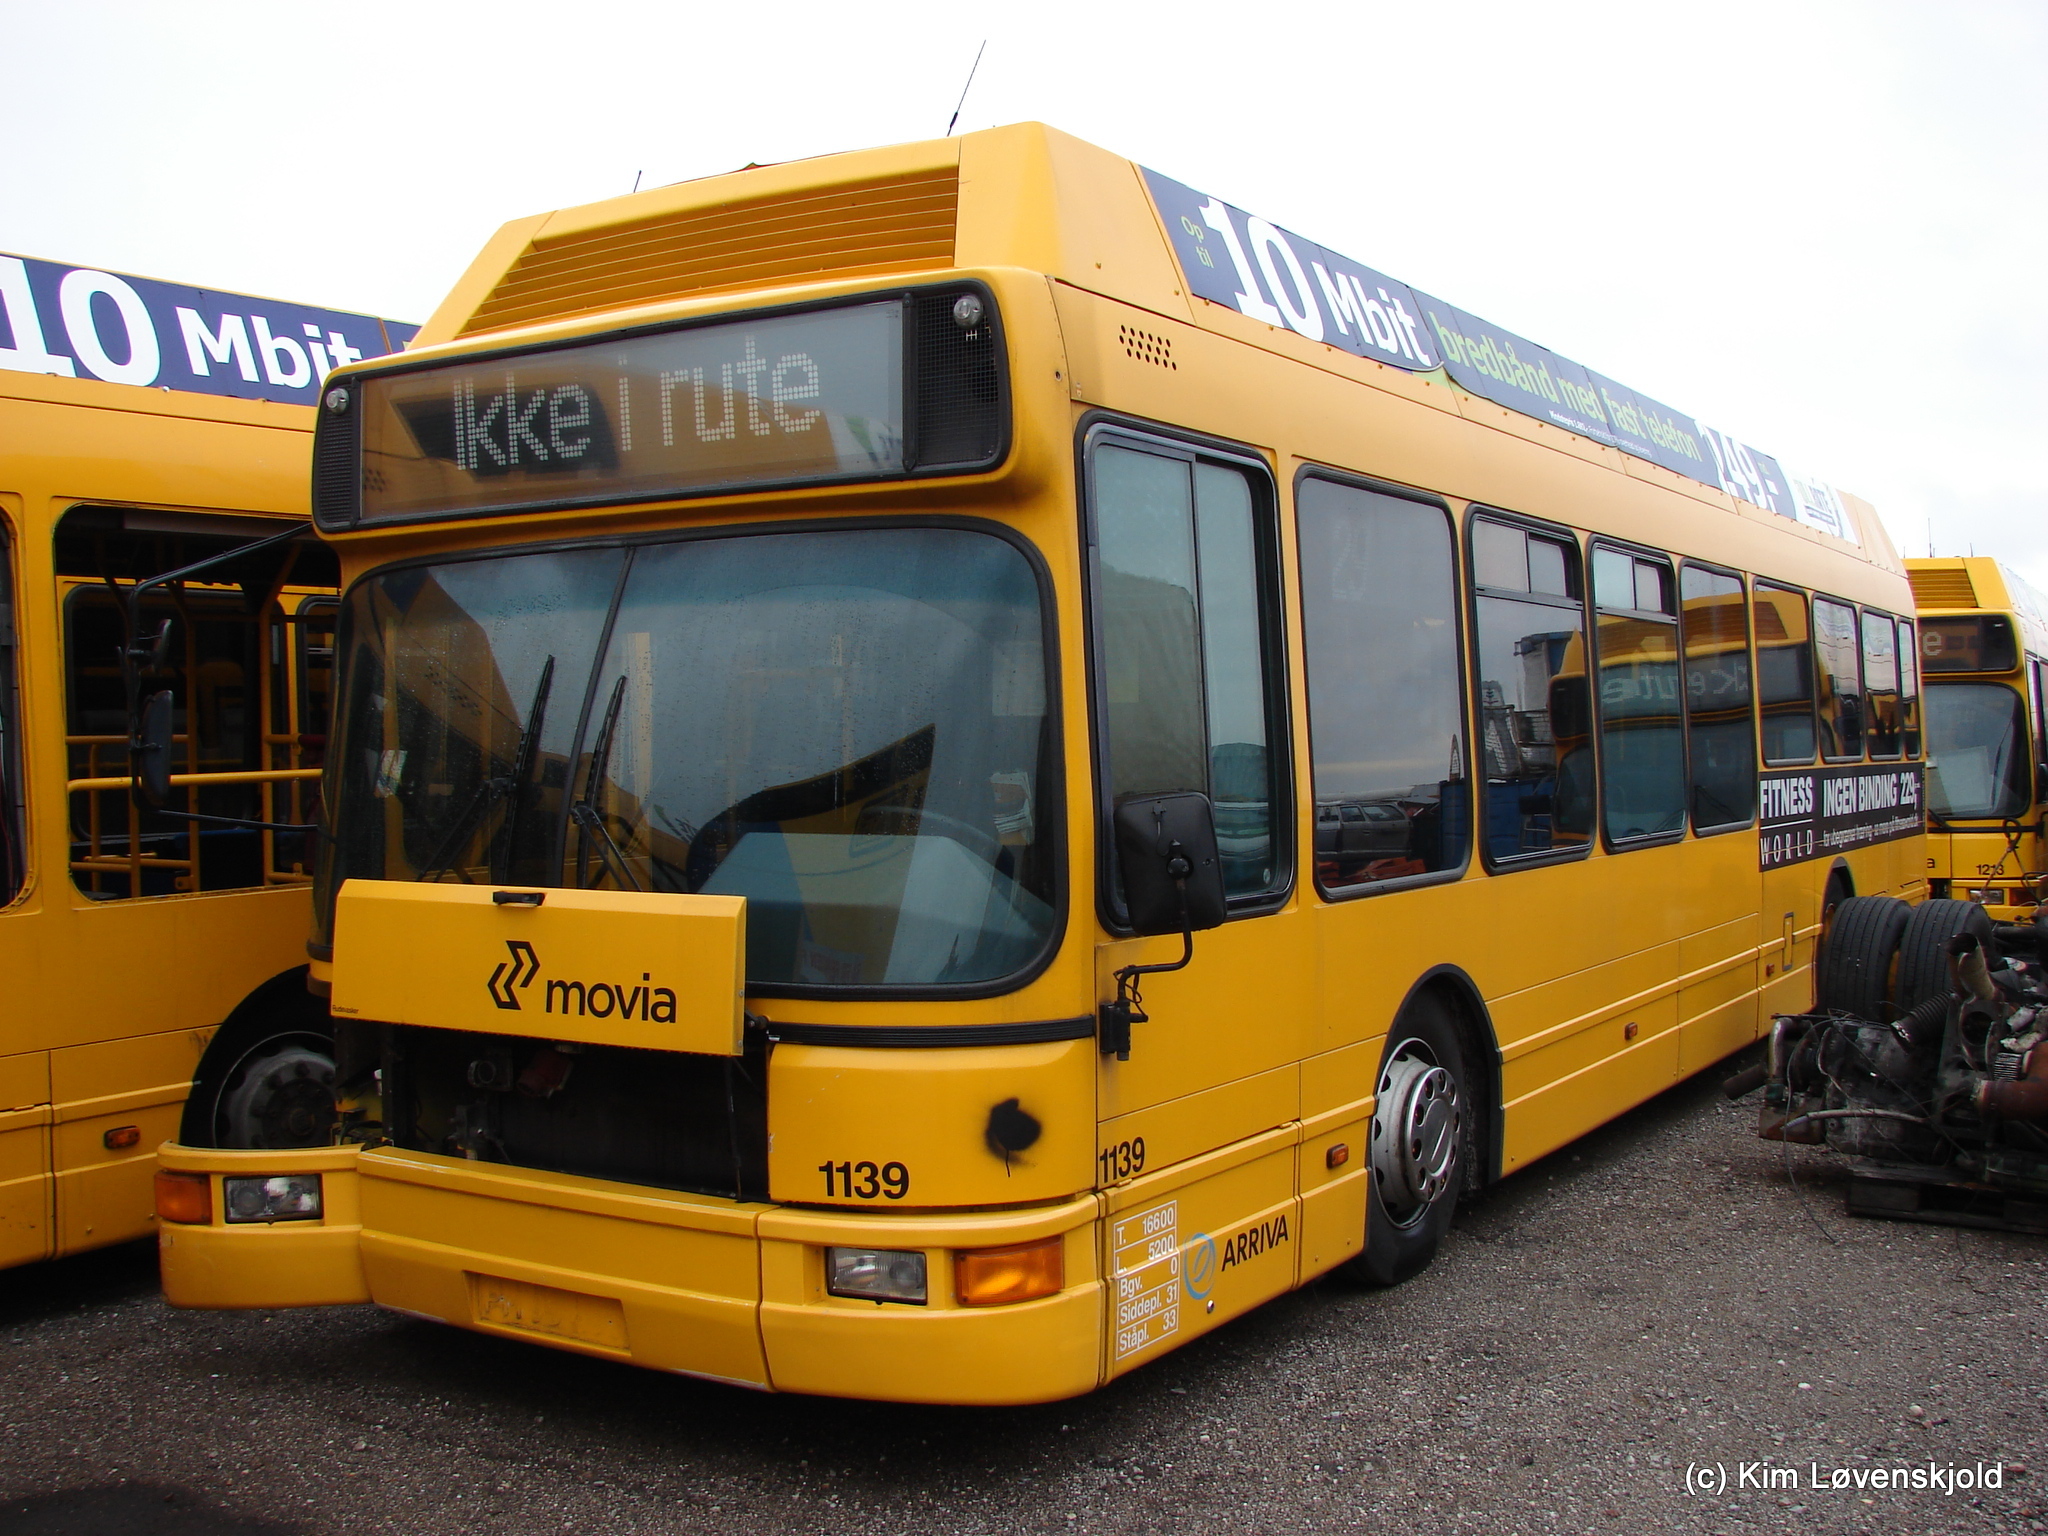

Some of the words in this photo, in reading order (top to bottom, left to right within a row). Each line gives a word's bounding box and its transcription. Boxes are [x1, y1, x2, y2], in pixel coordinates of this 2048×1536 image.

[1180, 216, 1205, 243] Op
[1194, 246, 1215, 269] til
[1198, 196, 1324, 342] 10
[1311, 261, 1432, 367] Mbit
[453, 370, 592, 470] Ikke
[617, 353, 632, 452] i
[660, 333, 821, 447] rute
[1428, 311, 1560, 404] bredbånd
[1556, 376, 1608, 424] med
[1601, 387, 1647, 439] fast
[1639, 406, 1703, 462] telefon
[1760, 776, 1813, 820] FITNESS
[1823, 775, 1857, 818] INGEN
[1858, 773, 1897, 812] BINDING
[1760, 829, 1813, 865] WORLD
[545, 972, 676, 1024] movia
[818, 1160, 910, 1200] 1139
[1100, 1136, 1145, 1184] 1139
[1117, 1227, 1126, 1246] T.
[1142, 1207, 1174, 1236] 16600
[1148, 1234, 1175, 1261] 5200
[1221, 1214, 1289, 1272] ARRIVA
[1120, 1277, 1143, 1299] Bgv.
[1120, 1293, 1162, 1326] Siddepl.
[1166, 1284, 1178, 1304] 31
[1119, 1326, 1149, 1352] Ståpl.
[1163, 1311, 1176, 1331] 33
